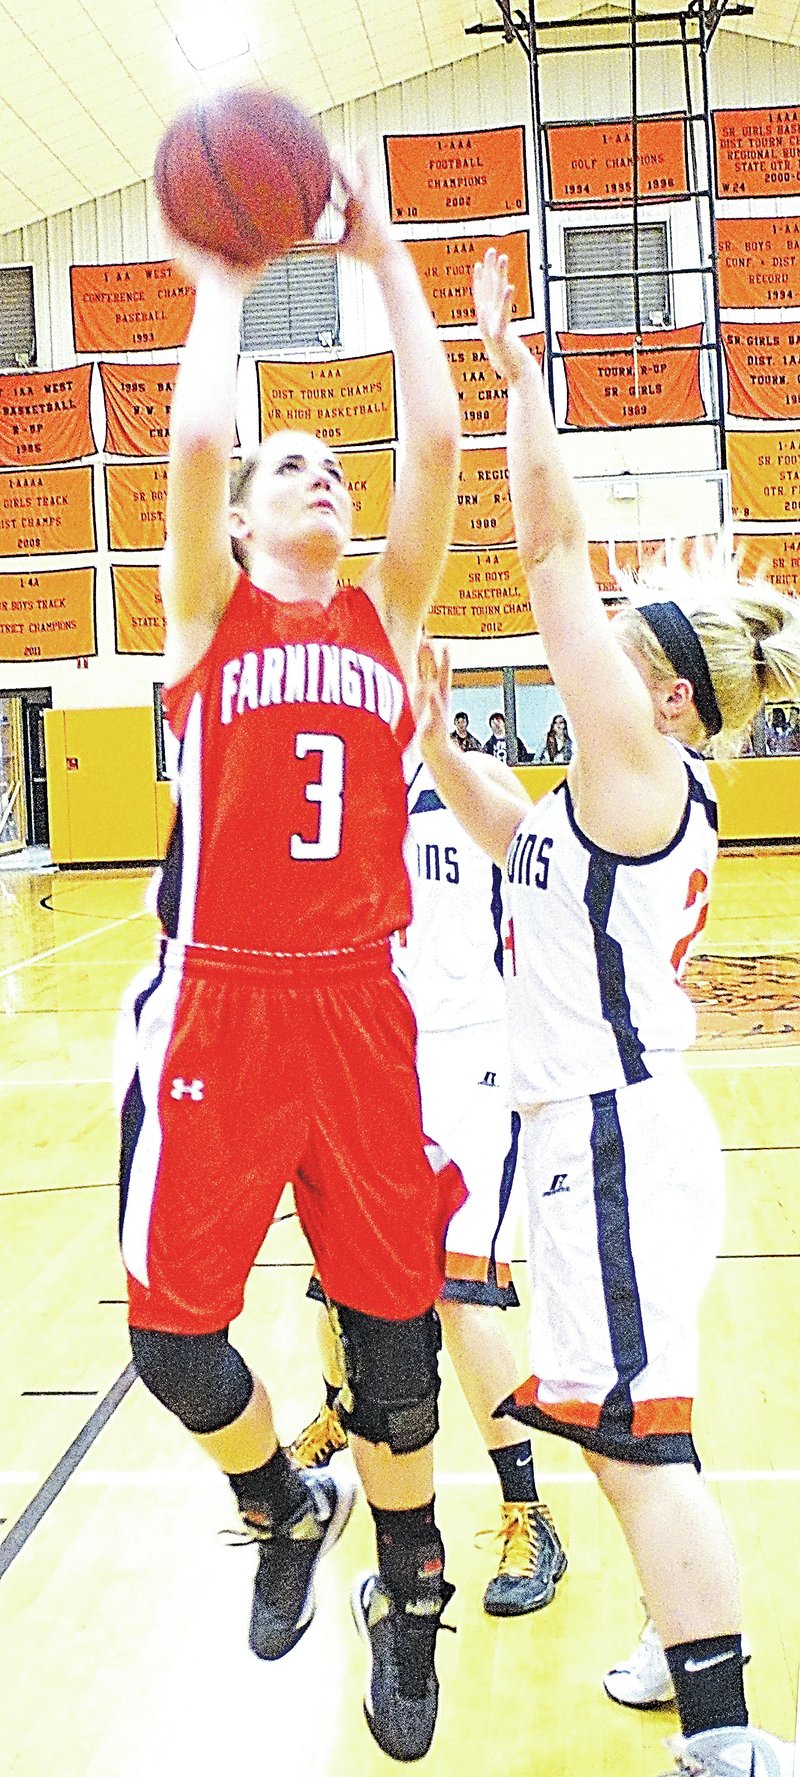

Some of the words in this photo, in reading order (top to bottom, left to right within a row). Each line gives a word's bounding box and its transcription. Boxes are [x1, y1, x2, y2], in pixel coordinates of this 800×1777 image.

[742, 125, 772, 137] GIRLS
[749, 137, 783, 148] TOURN
[727, 149, 777, 160] REGIONAL
[429, 157, 483, 170] FOOTBALL
[571, 159, 597, 170] GOLF
[735, 161, 766, 172] STATE
[427, 175, 487, 189] CHAMPIONS
[564, 184, 590, 194] 1994
[445, 196, 471, 207] 2002
[745, 241, 771, 252] BOYS
[145, 268, 172, 279] WEST
[446, 265, 475, 276] FOOT
[749, 274, 788, 284] RECORD
[82, 291, 145, 303] CONFERENCE
[157, 286, 196, 299] CHAMPS
[115, 311, 167, 323] BASEBALL
[747, 336, 779, 346] GIRLS
[641, 364, 667, 375] R-UP
[44, 381, 73, 393] WEST
[272, 390, 294, 399] DIST
[300, 389, 334, 399] TOURN
[340, 382, 382, 397] CHAMPS
[604, 387, 618, 396] SR
[3, 399, 77, 415] BASKETBALL
[287, 408, 311, 419] HIGH
[317, 402, 387, 419] BASKETBALL
[3, 497, 32, 508] GIRLS
[36, 495, 69, 507] TRACK
[21, 516, 62, 528] CHAMPS
[468, 573, 480, 583] SR
[485, 571, 510, 581] BOYS
[459, 587, 520, 600] BASKETBALL
[11, 601, 34, 611] BOYS
[36, 598, 66, 610] TRACK
[471, 604, 500, 616] TOURN
[29, 620, 77, 633] CHAMPIONS
[481, 622, 503, 632] 2012
[290, 731, 346, 860] 3
